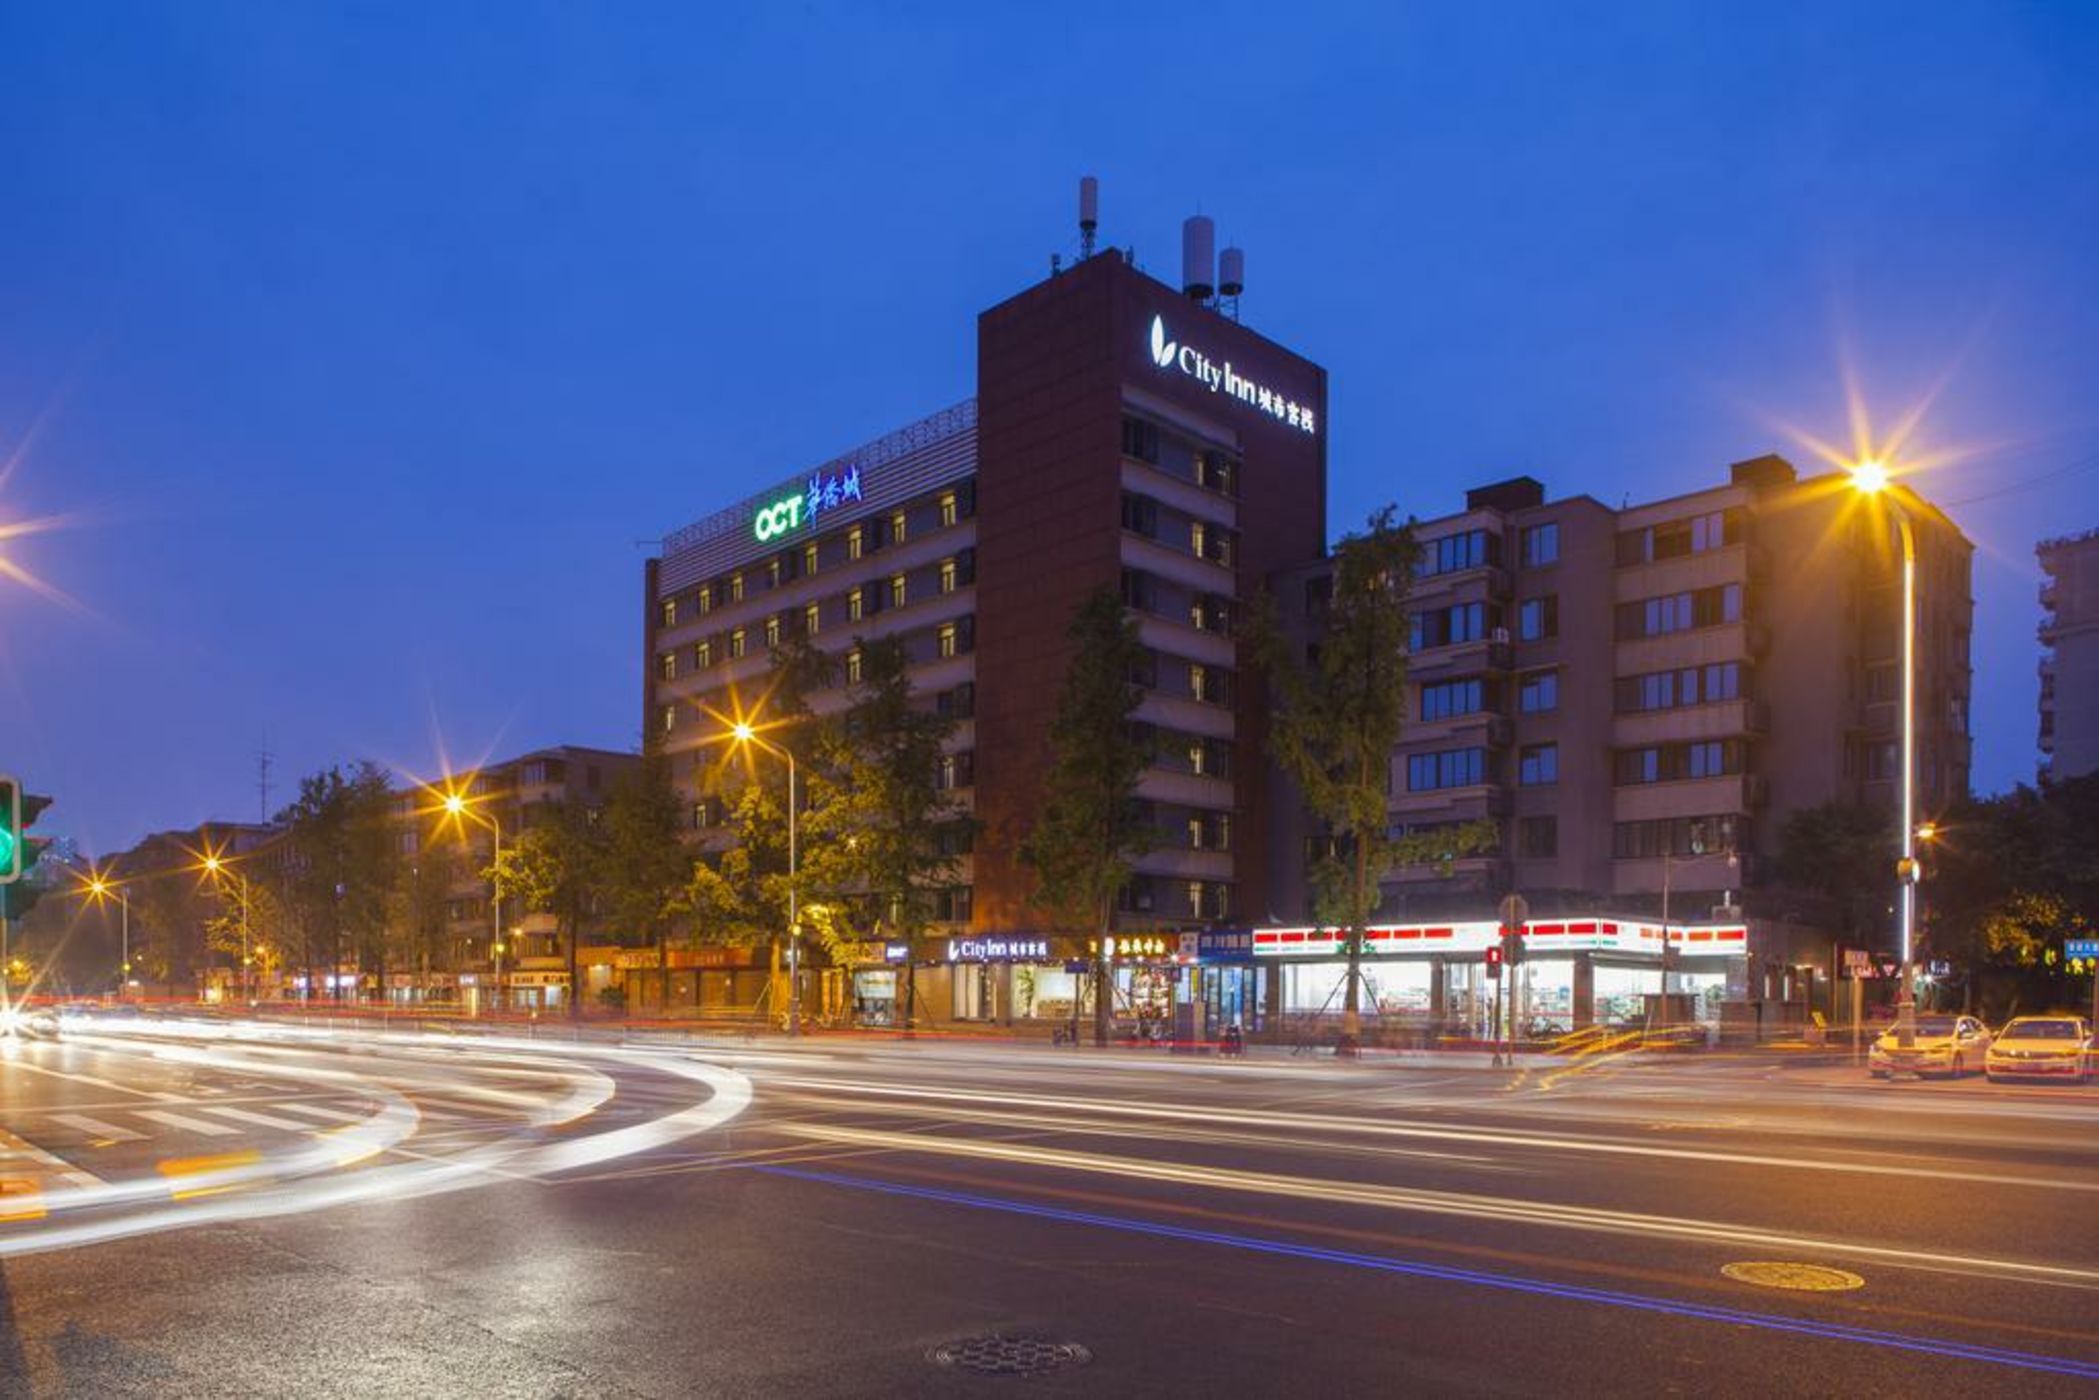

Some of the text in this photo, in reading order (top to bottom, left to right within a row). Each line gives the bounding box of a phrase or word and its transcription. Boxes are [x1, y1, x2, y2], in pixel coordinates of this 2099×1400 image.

[1178, 345, 1222, 393] City
[1225, 361, 1256, 404] Inn
[755, 494, 803, 541] OCT
[961, 940, 985, 959] City
